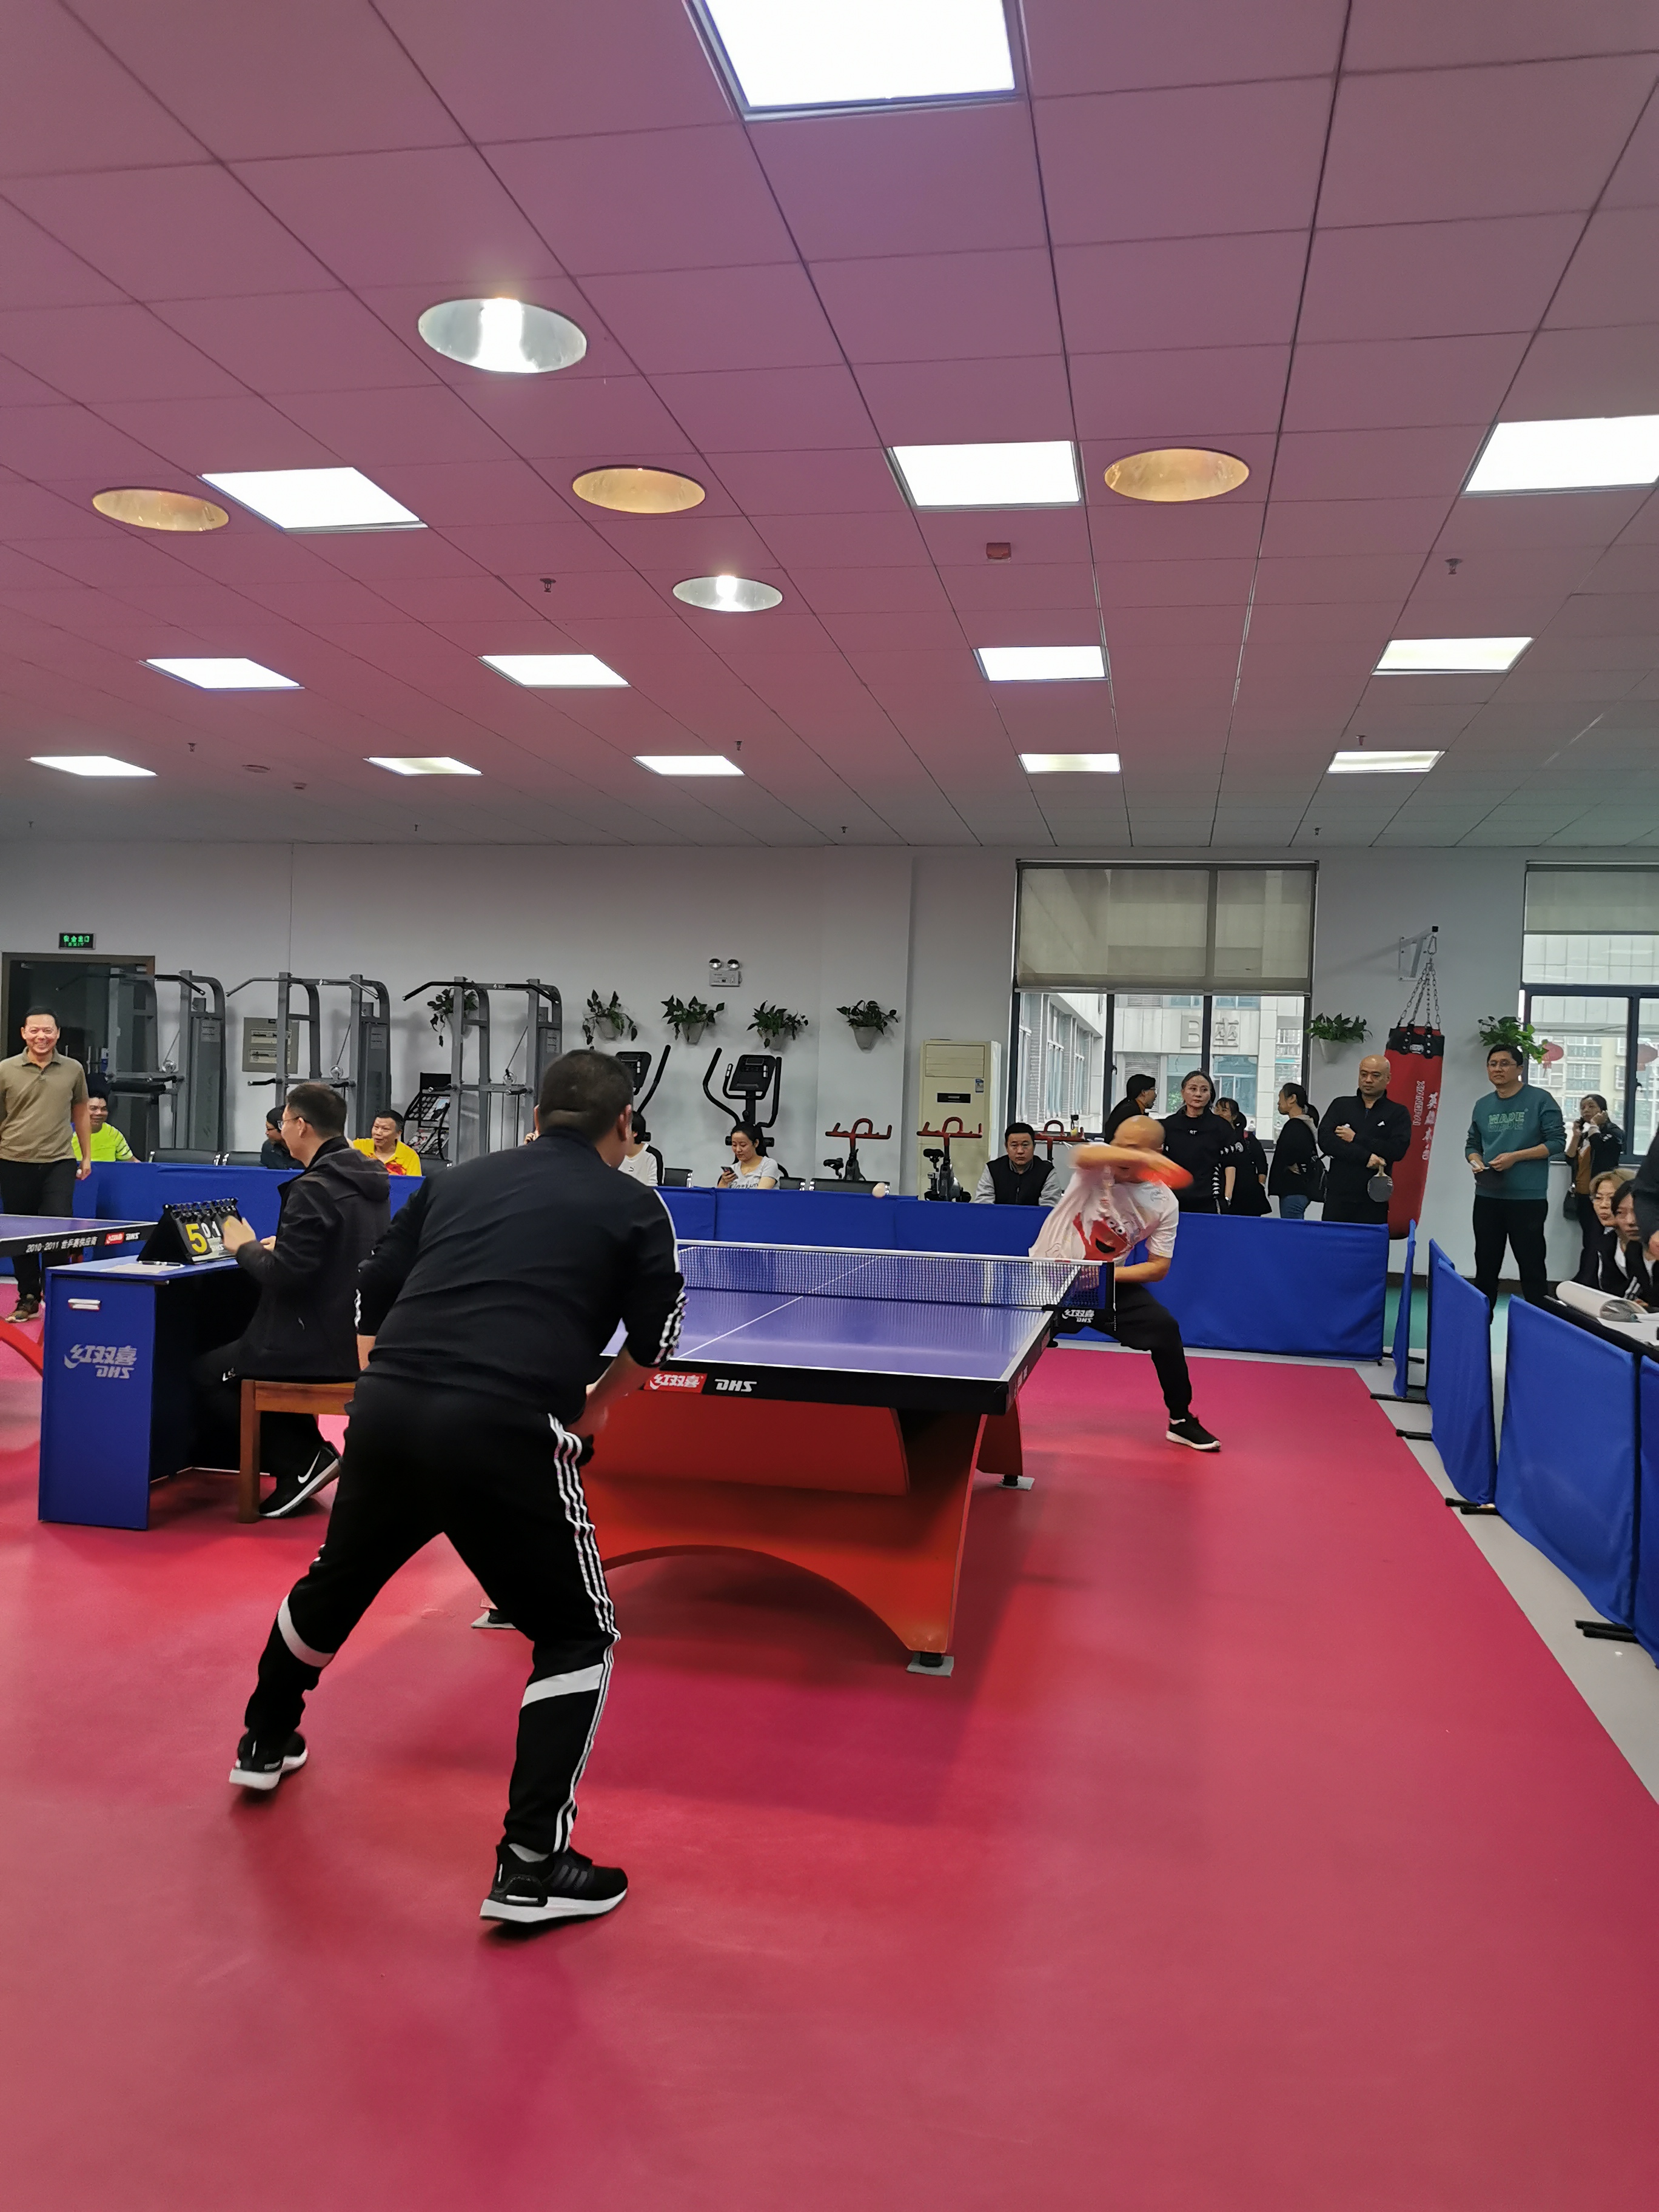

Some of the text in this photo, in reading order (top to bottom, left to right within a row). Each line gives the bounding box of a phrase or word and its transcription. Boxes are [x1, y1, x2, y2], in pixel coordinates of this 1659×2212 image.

[186, 1223, 207, 1253] 5
[25, 1241, 59, 1253] 2010-2011
[64, 1344, 138, 1369] 红双喜
[95, 1365, 135, 1379] DHS
[649, 1373, 700, 1390] 红双喜
[714, 1378, 757, 1392] DHS
